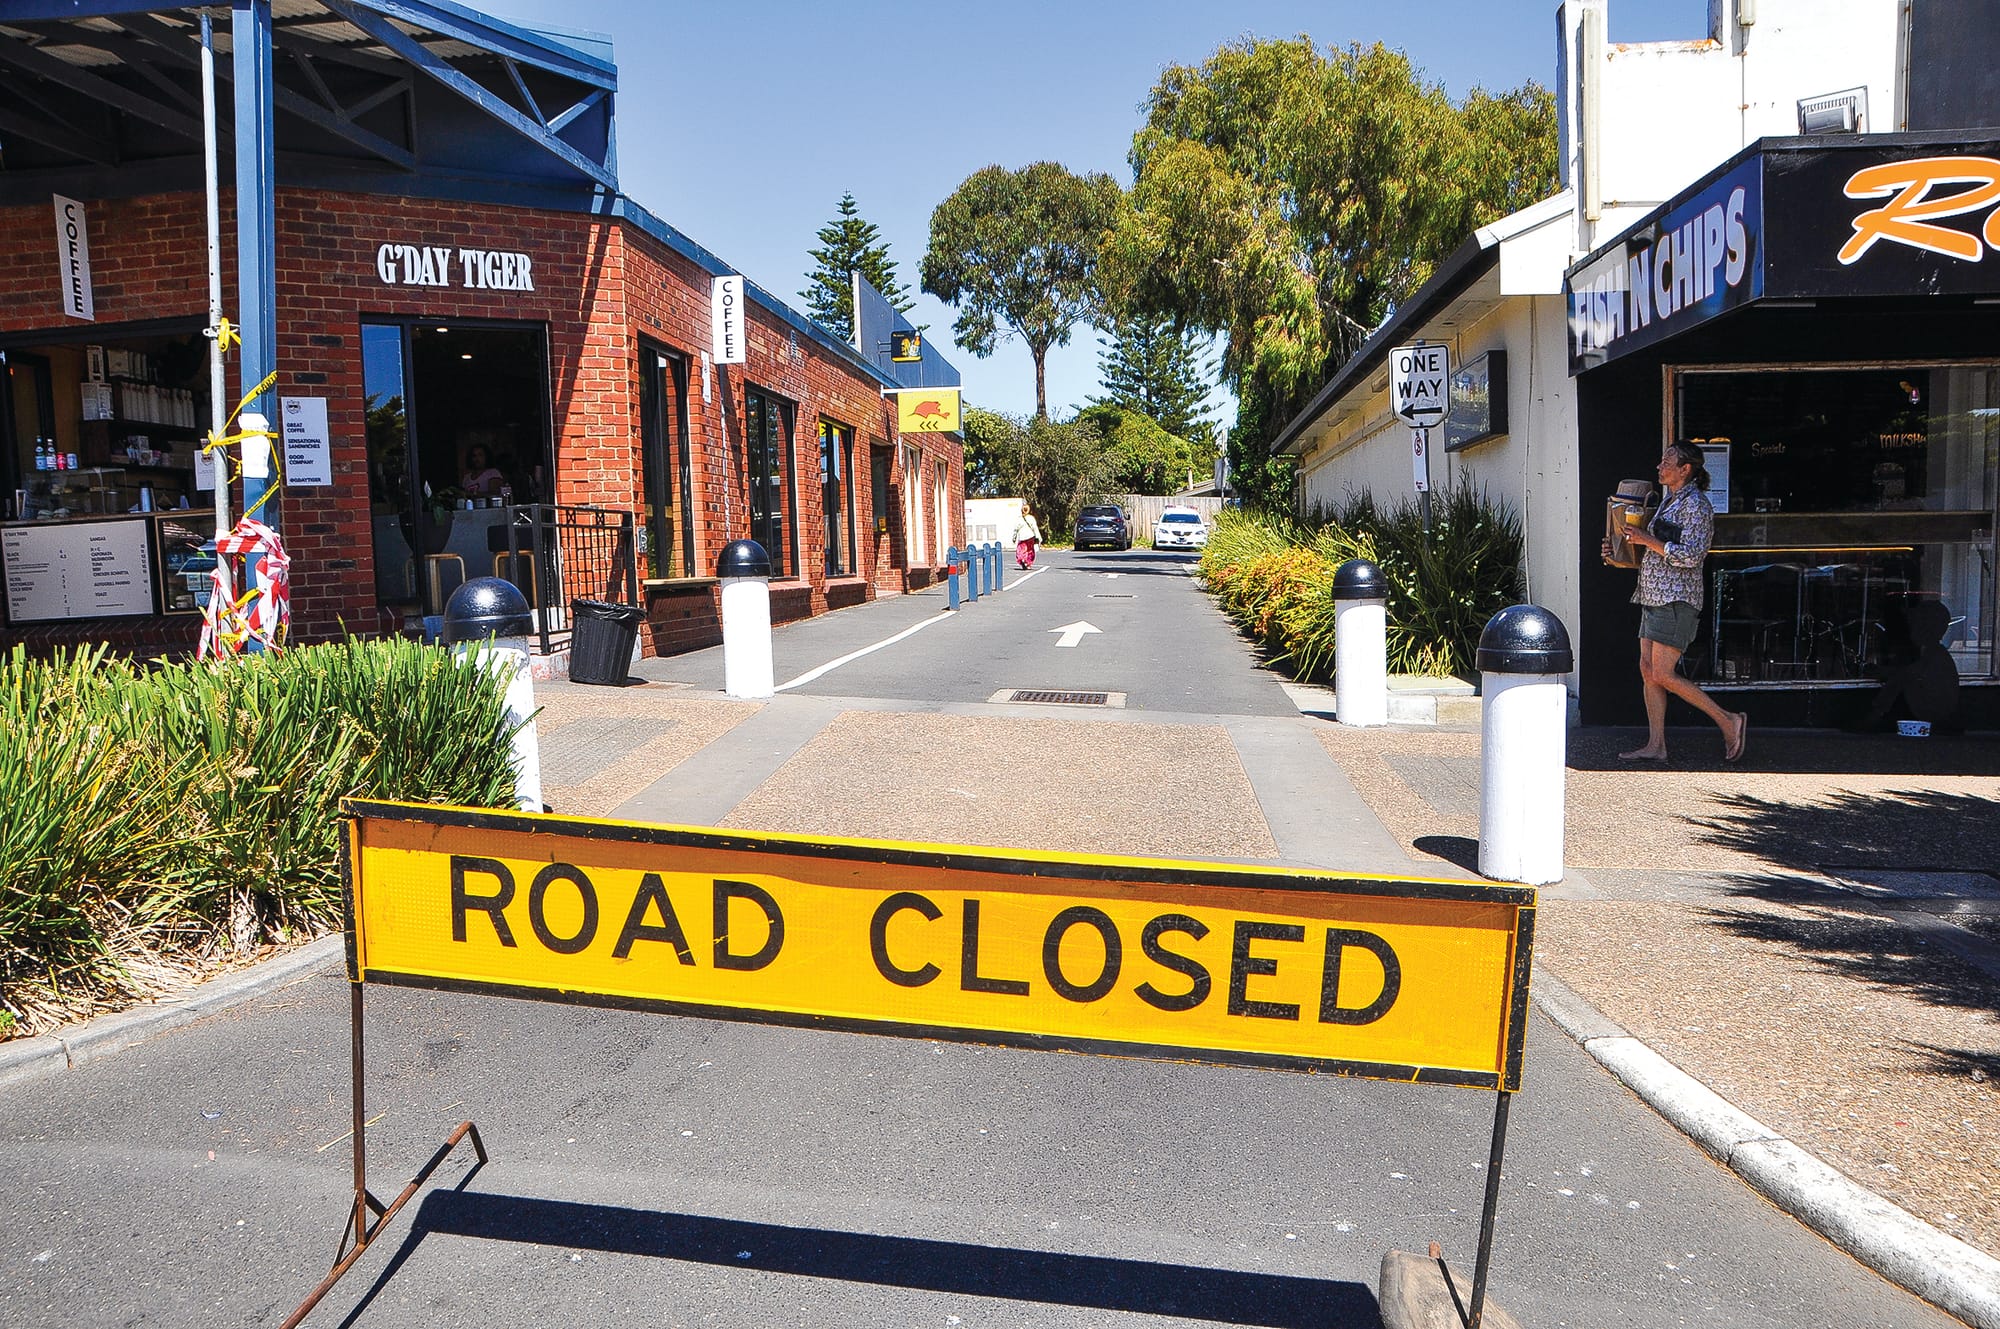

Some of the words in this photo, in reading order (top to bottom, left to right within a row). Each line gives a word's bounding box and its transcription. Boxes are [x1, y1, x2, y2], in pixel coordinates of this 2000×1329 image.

[1837, 156, 2000, 265] R
[65, 204, 84, 313] COFFEE
[377, 243, 451, 287] G'DAY
[459, 248, 535, 291] TIGER
[1574, 263, 1624, 357] FISH
[1629, 248, 1651, 332] N
[1654, 186, 1747, 320] CHIPS
[722, 281, 734, 358] COFFEE
[1400, 354, 1440, 373] ONE
[1398, 378, 1443, 399] WAY
[450, 855, 786, 972] ROAD
[869, 891, 1402, 1027] CLOSED
